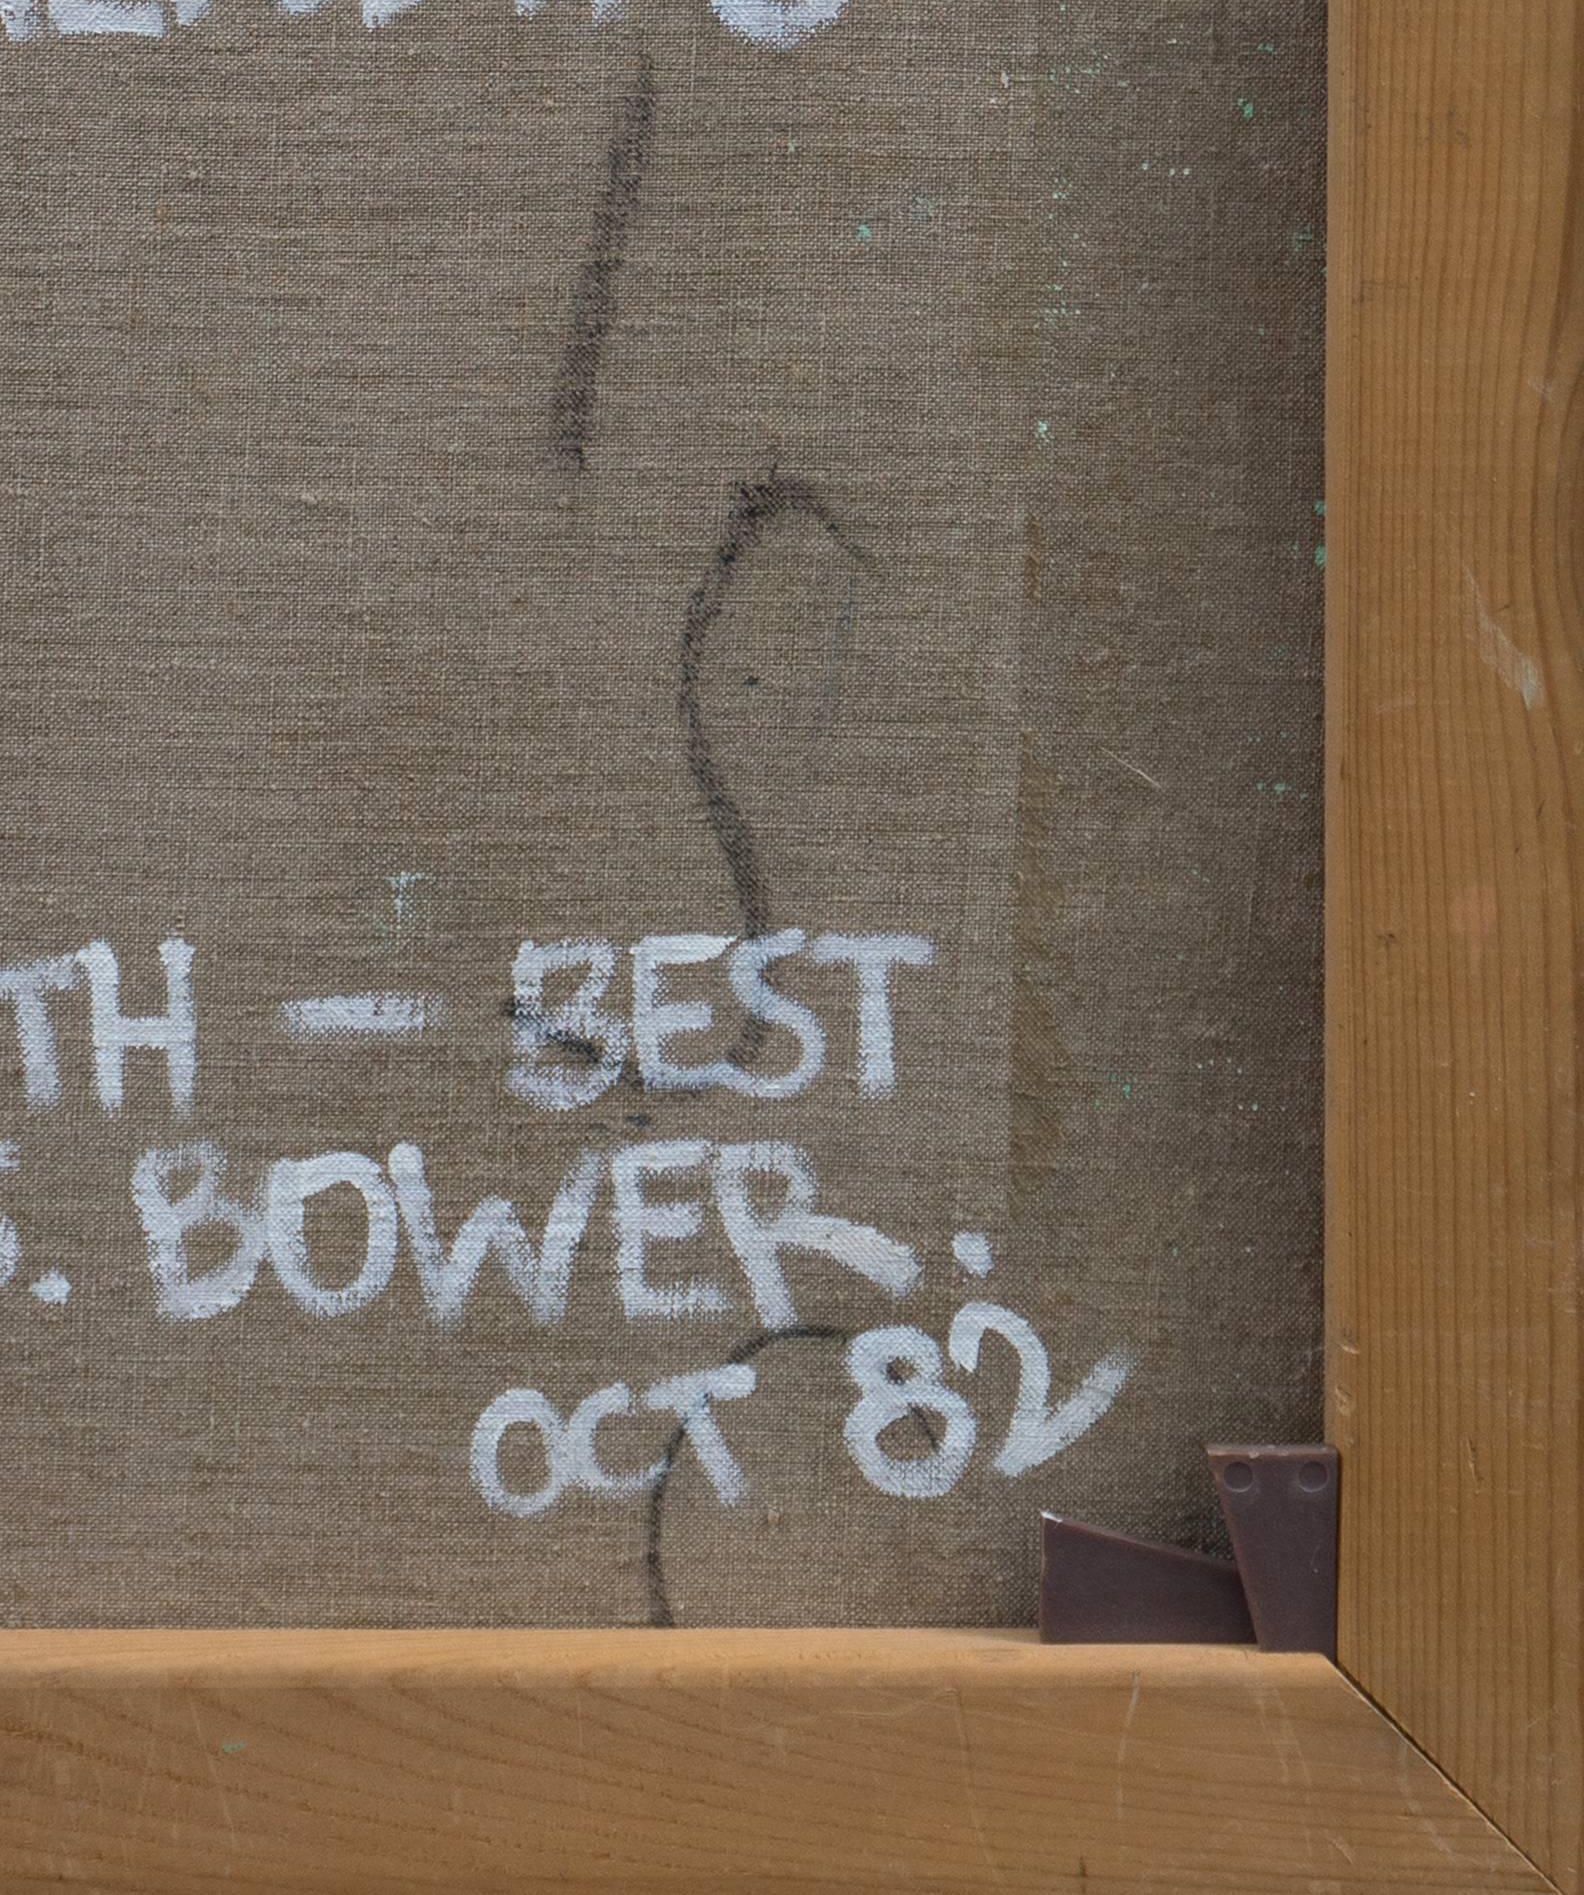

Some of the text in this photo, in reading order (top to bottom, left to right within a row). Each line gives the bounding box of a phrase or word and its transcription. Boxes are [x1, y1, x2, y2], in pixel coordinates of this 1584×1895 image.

[510, 928, 931, 1109] BEST
[470, 1365, 754, 1516] OCT
[844, 1302, 1123, 1497] 82
